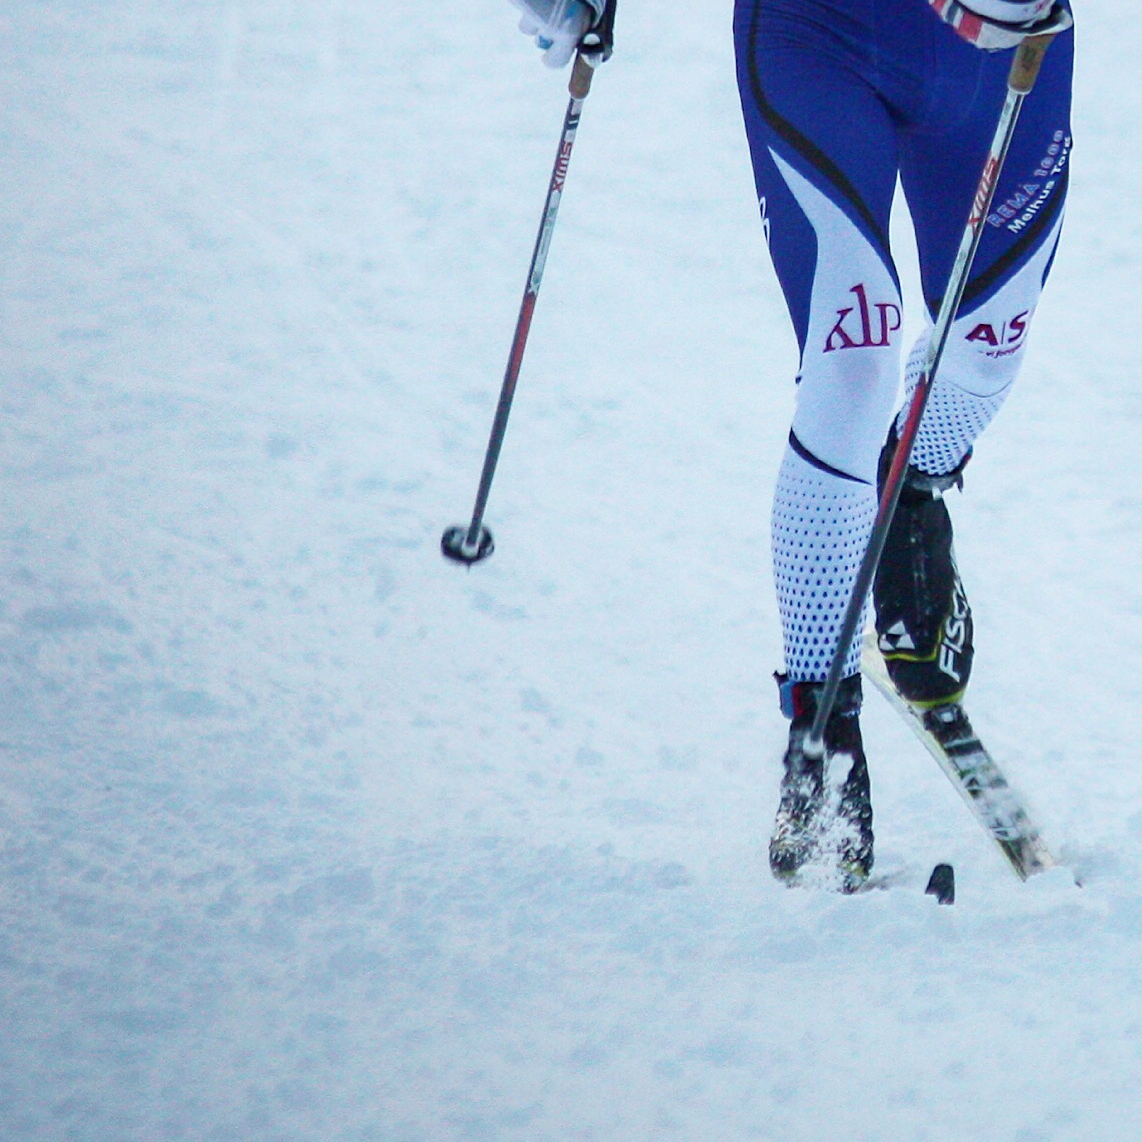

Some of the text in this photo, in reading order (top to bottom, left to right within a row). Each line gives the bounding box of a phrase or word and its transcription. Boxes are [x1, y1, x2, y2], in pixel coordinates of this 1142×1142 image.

[987, 130, 1063, 227] REMA 1000
[1007, 180, 1055, 234] Melhus
